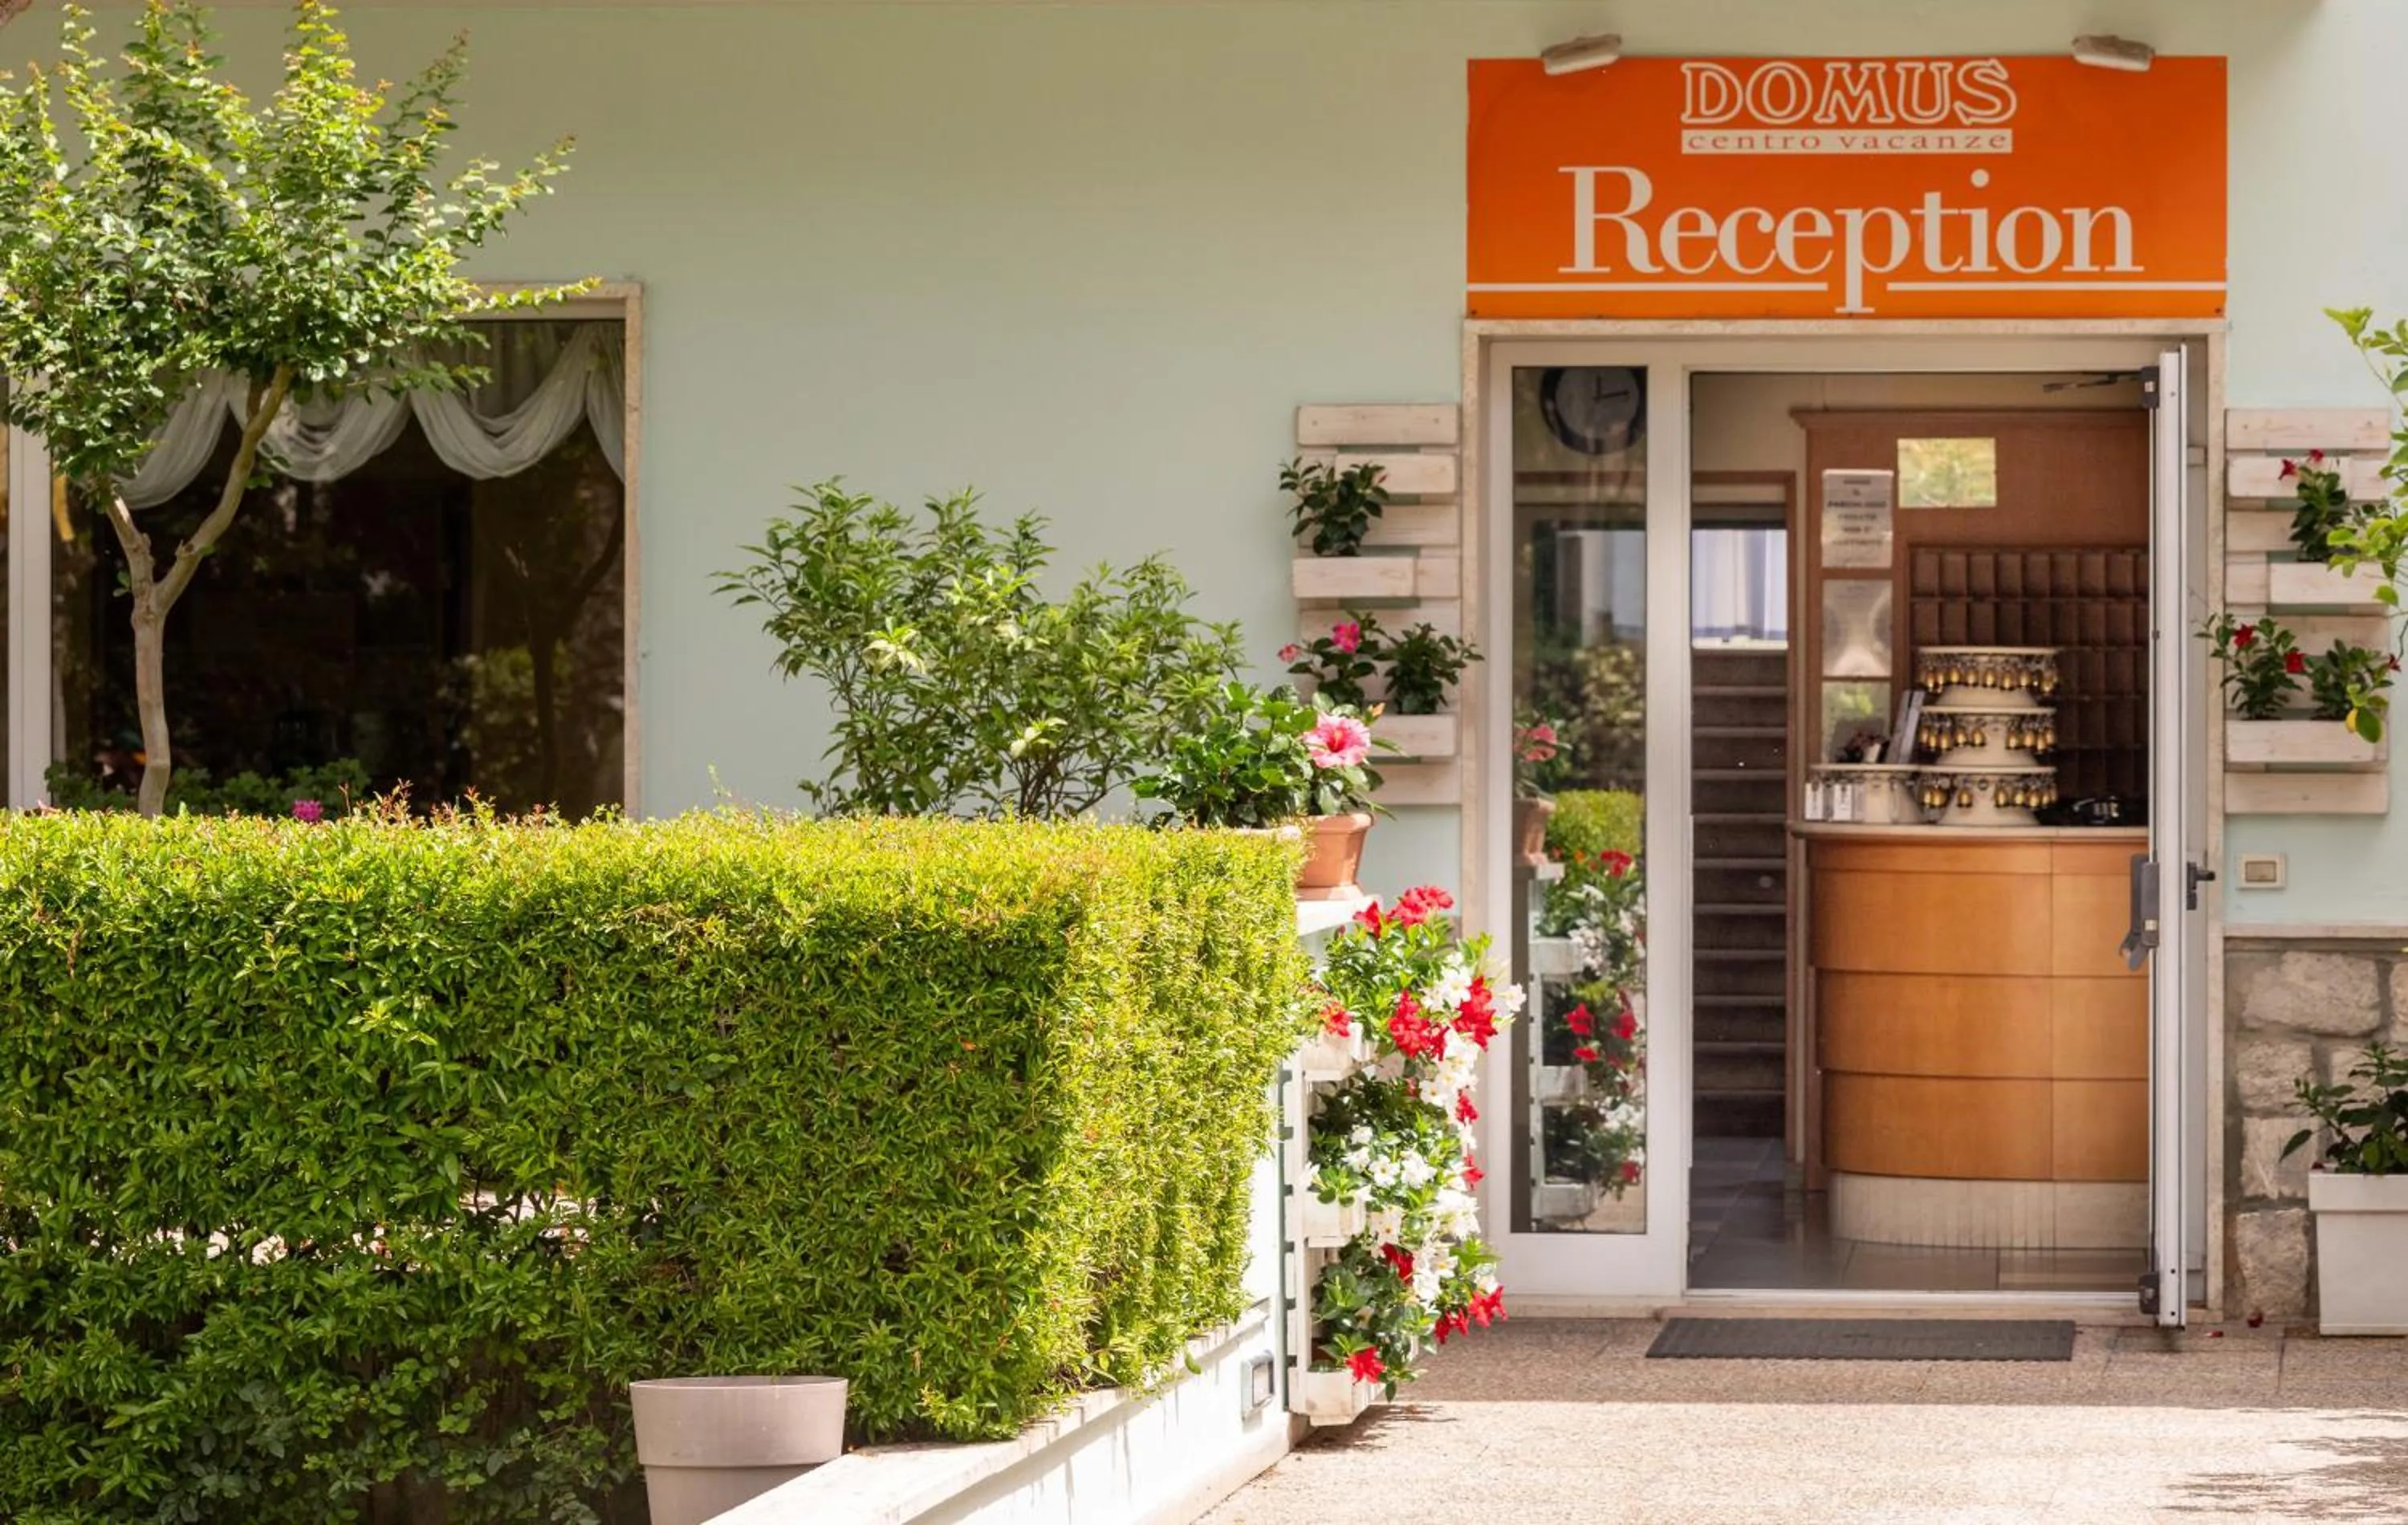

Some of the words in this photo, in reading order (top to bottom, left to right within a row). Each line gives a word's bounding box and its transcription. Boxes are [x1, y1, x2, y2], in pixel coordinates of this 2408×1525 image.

[1681, 59, 2017, 124] DOMUS
[1688, 134, 1820, 149] centro
[1839, 134, 2006, 149] vacanze
[1558, 166, 2144, 312] Reception
